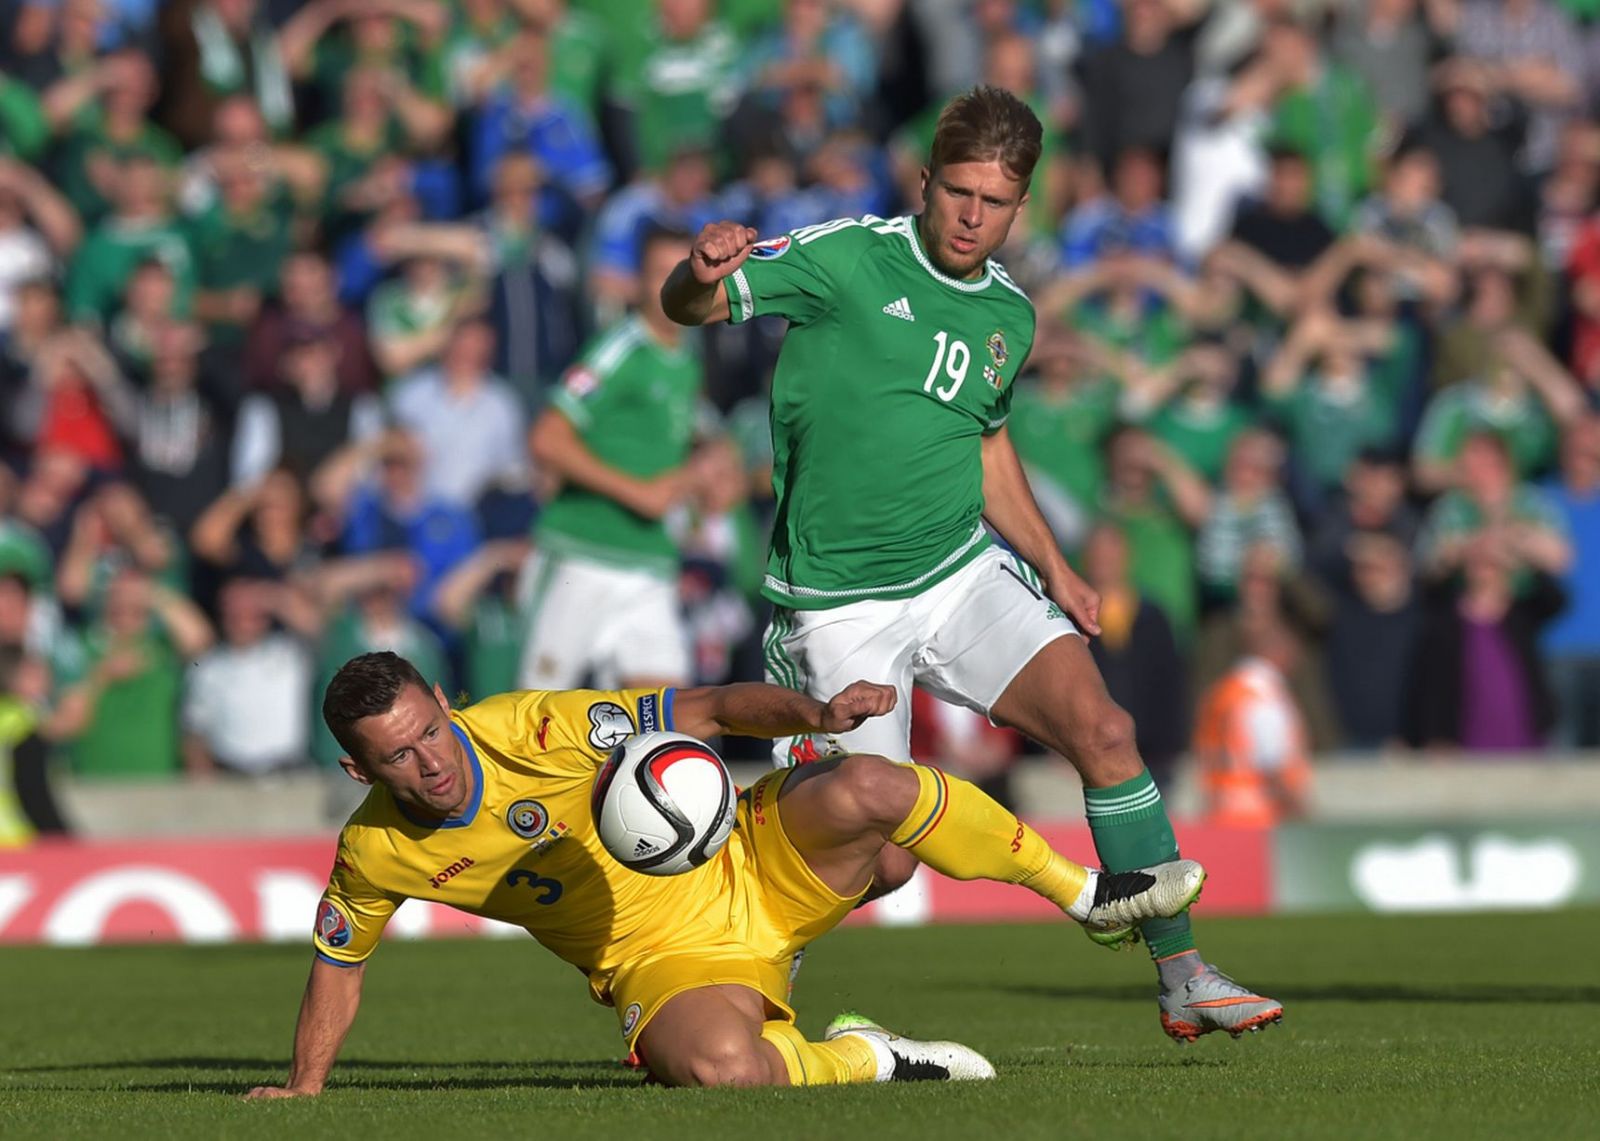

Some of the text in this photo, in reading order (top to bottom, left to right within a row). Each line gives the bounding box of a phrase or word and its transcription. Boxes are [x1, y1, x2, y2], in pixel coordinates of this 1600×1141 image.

[882, 305, 915, 322] adidas
[923, 330, 971, 402] 19
[506, 869, 564, 906] 3
